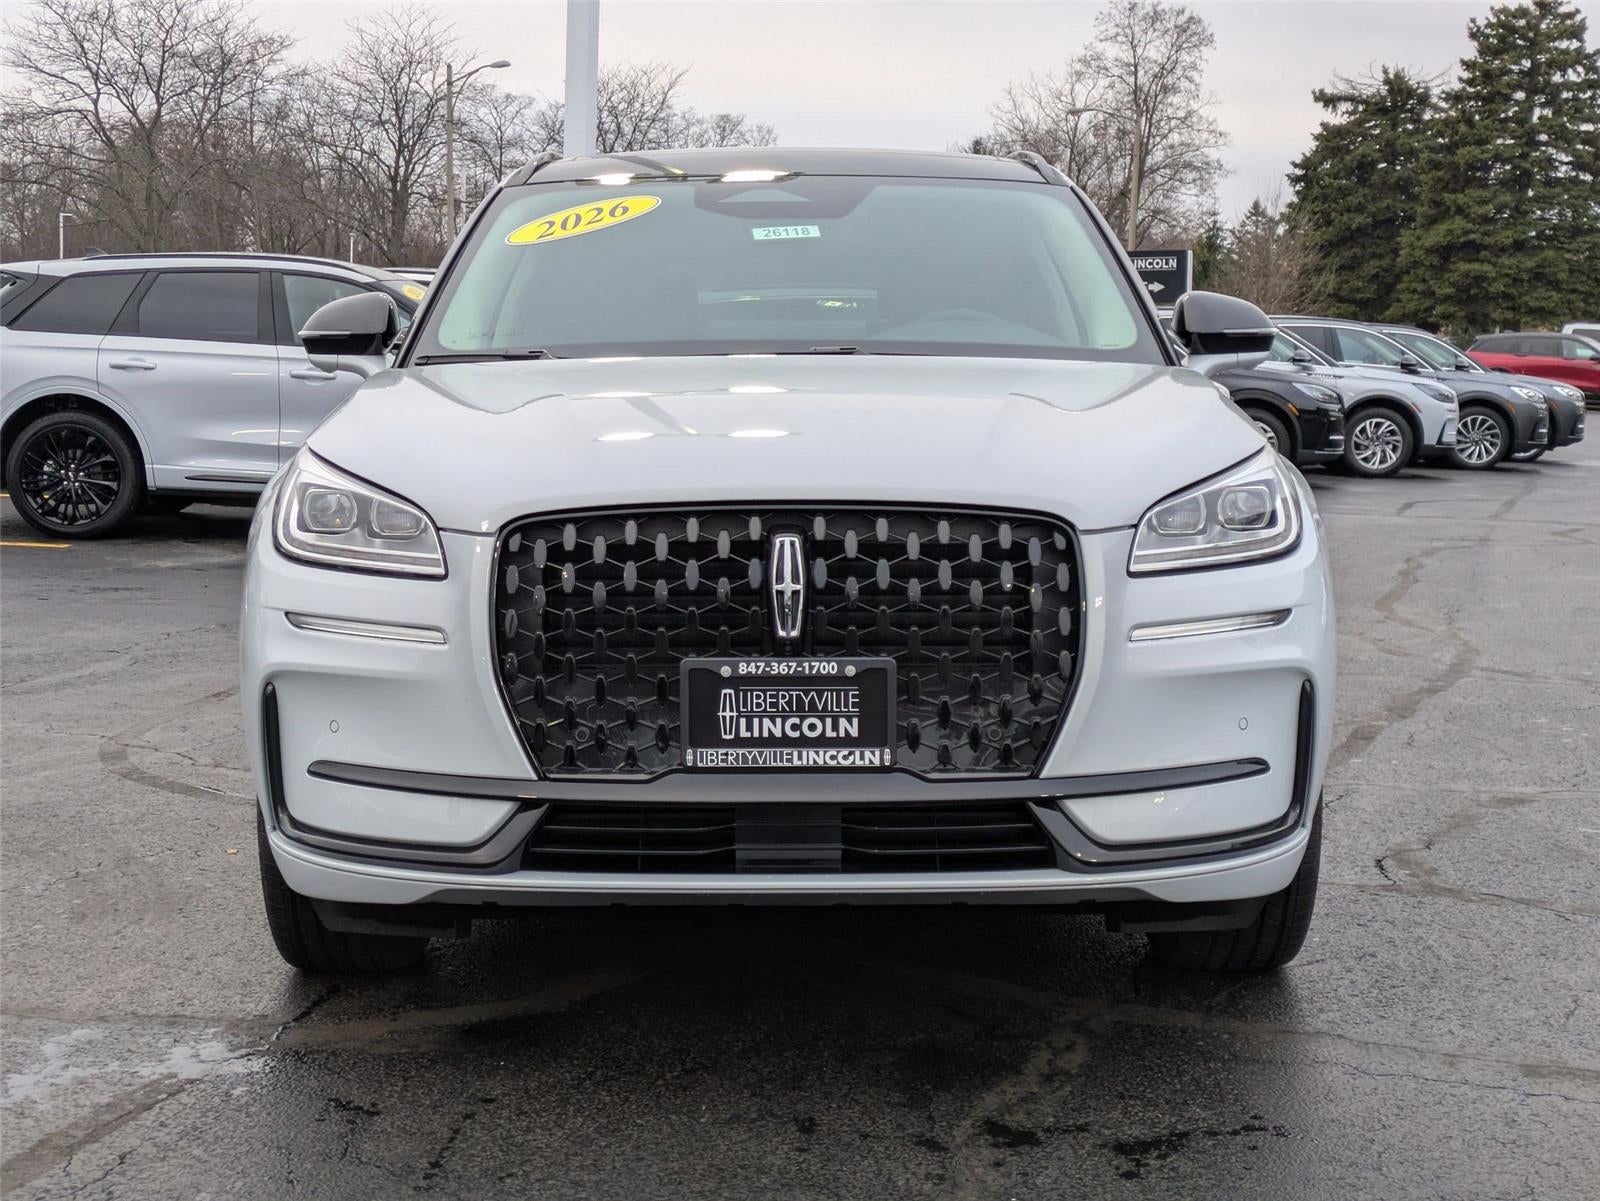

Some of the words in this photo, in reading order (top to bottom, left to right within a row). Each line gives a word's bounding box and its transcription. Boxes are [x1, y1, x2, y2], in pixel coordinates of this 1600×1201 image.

[535, 200, 630, 240] 2026
[762, 227, 810, 238] 26118
[1134, 259, 1177, 268] INCOLN
[738, 662, 838, 675] 847-367-1700
[739, 691, 860, 712] LIBERTYVILLE
[739, 717, 859, 738] LINCOLN
